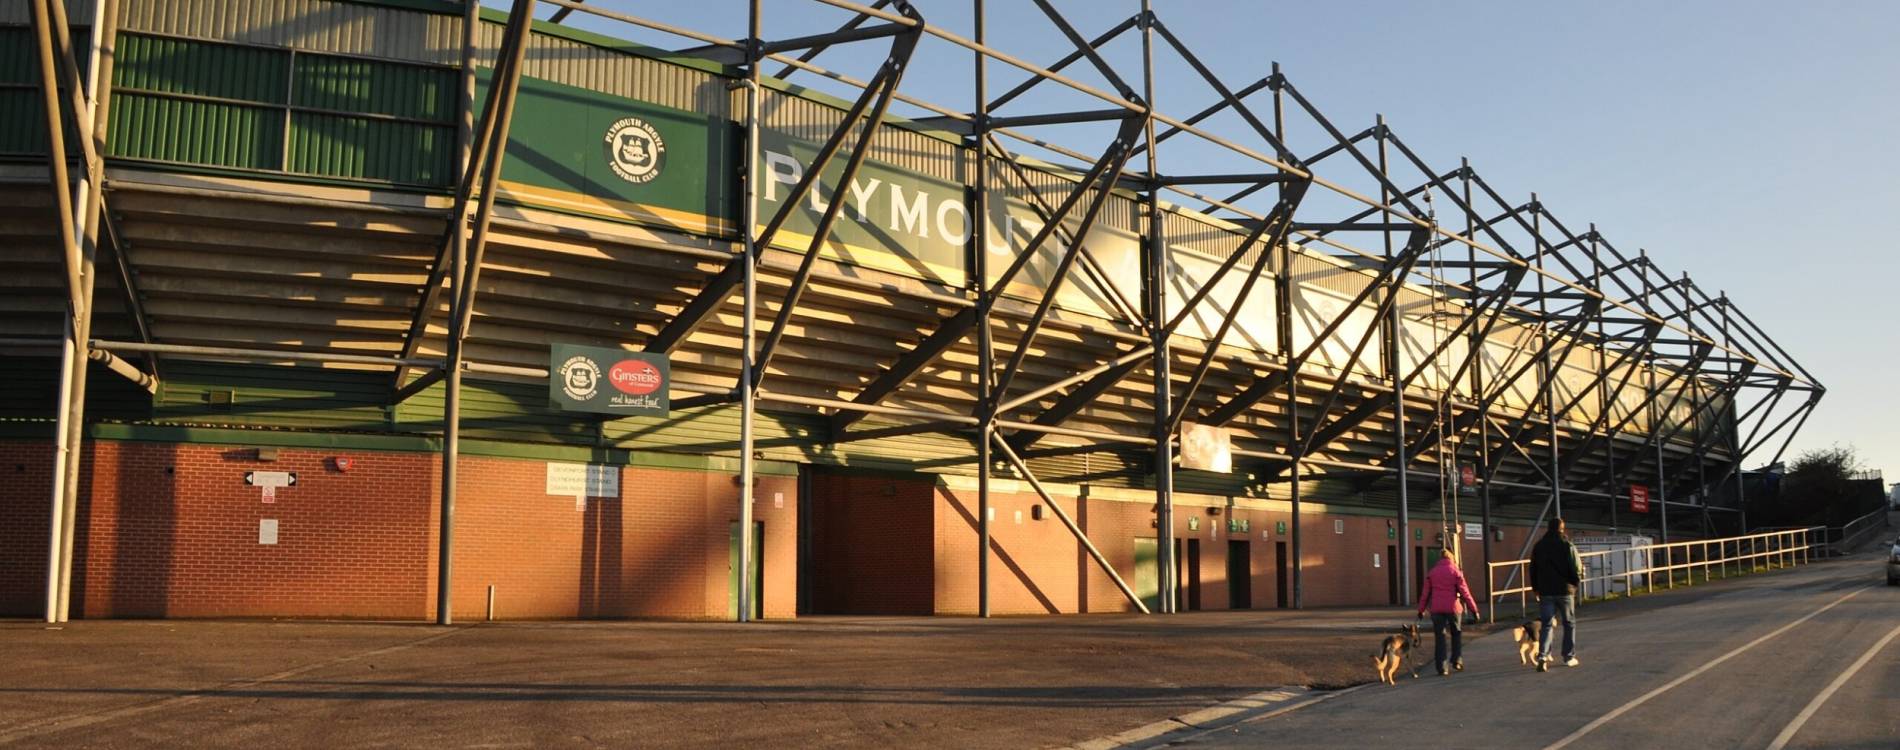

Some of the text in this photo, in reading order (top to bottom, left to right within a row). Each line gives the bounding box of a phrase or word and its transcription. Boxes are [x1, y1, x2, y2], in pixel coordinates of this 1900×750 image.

[604, 118, 665, 153] PLYMOUTH ARGYLE
[609, 161, 659, 183] FOOTBALL CLUB
[560, 356, 602, 378] PLYMOUTH ARGYLE
[562, 387, 598, 401] FOOTBALL CLUB
[611, 393, 661, 408] real honest food
